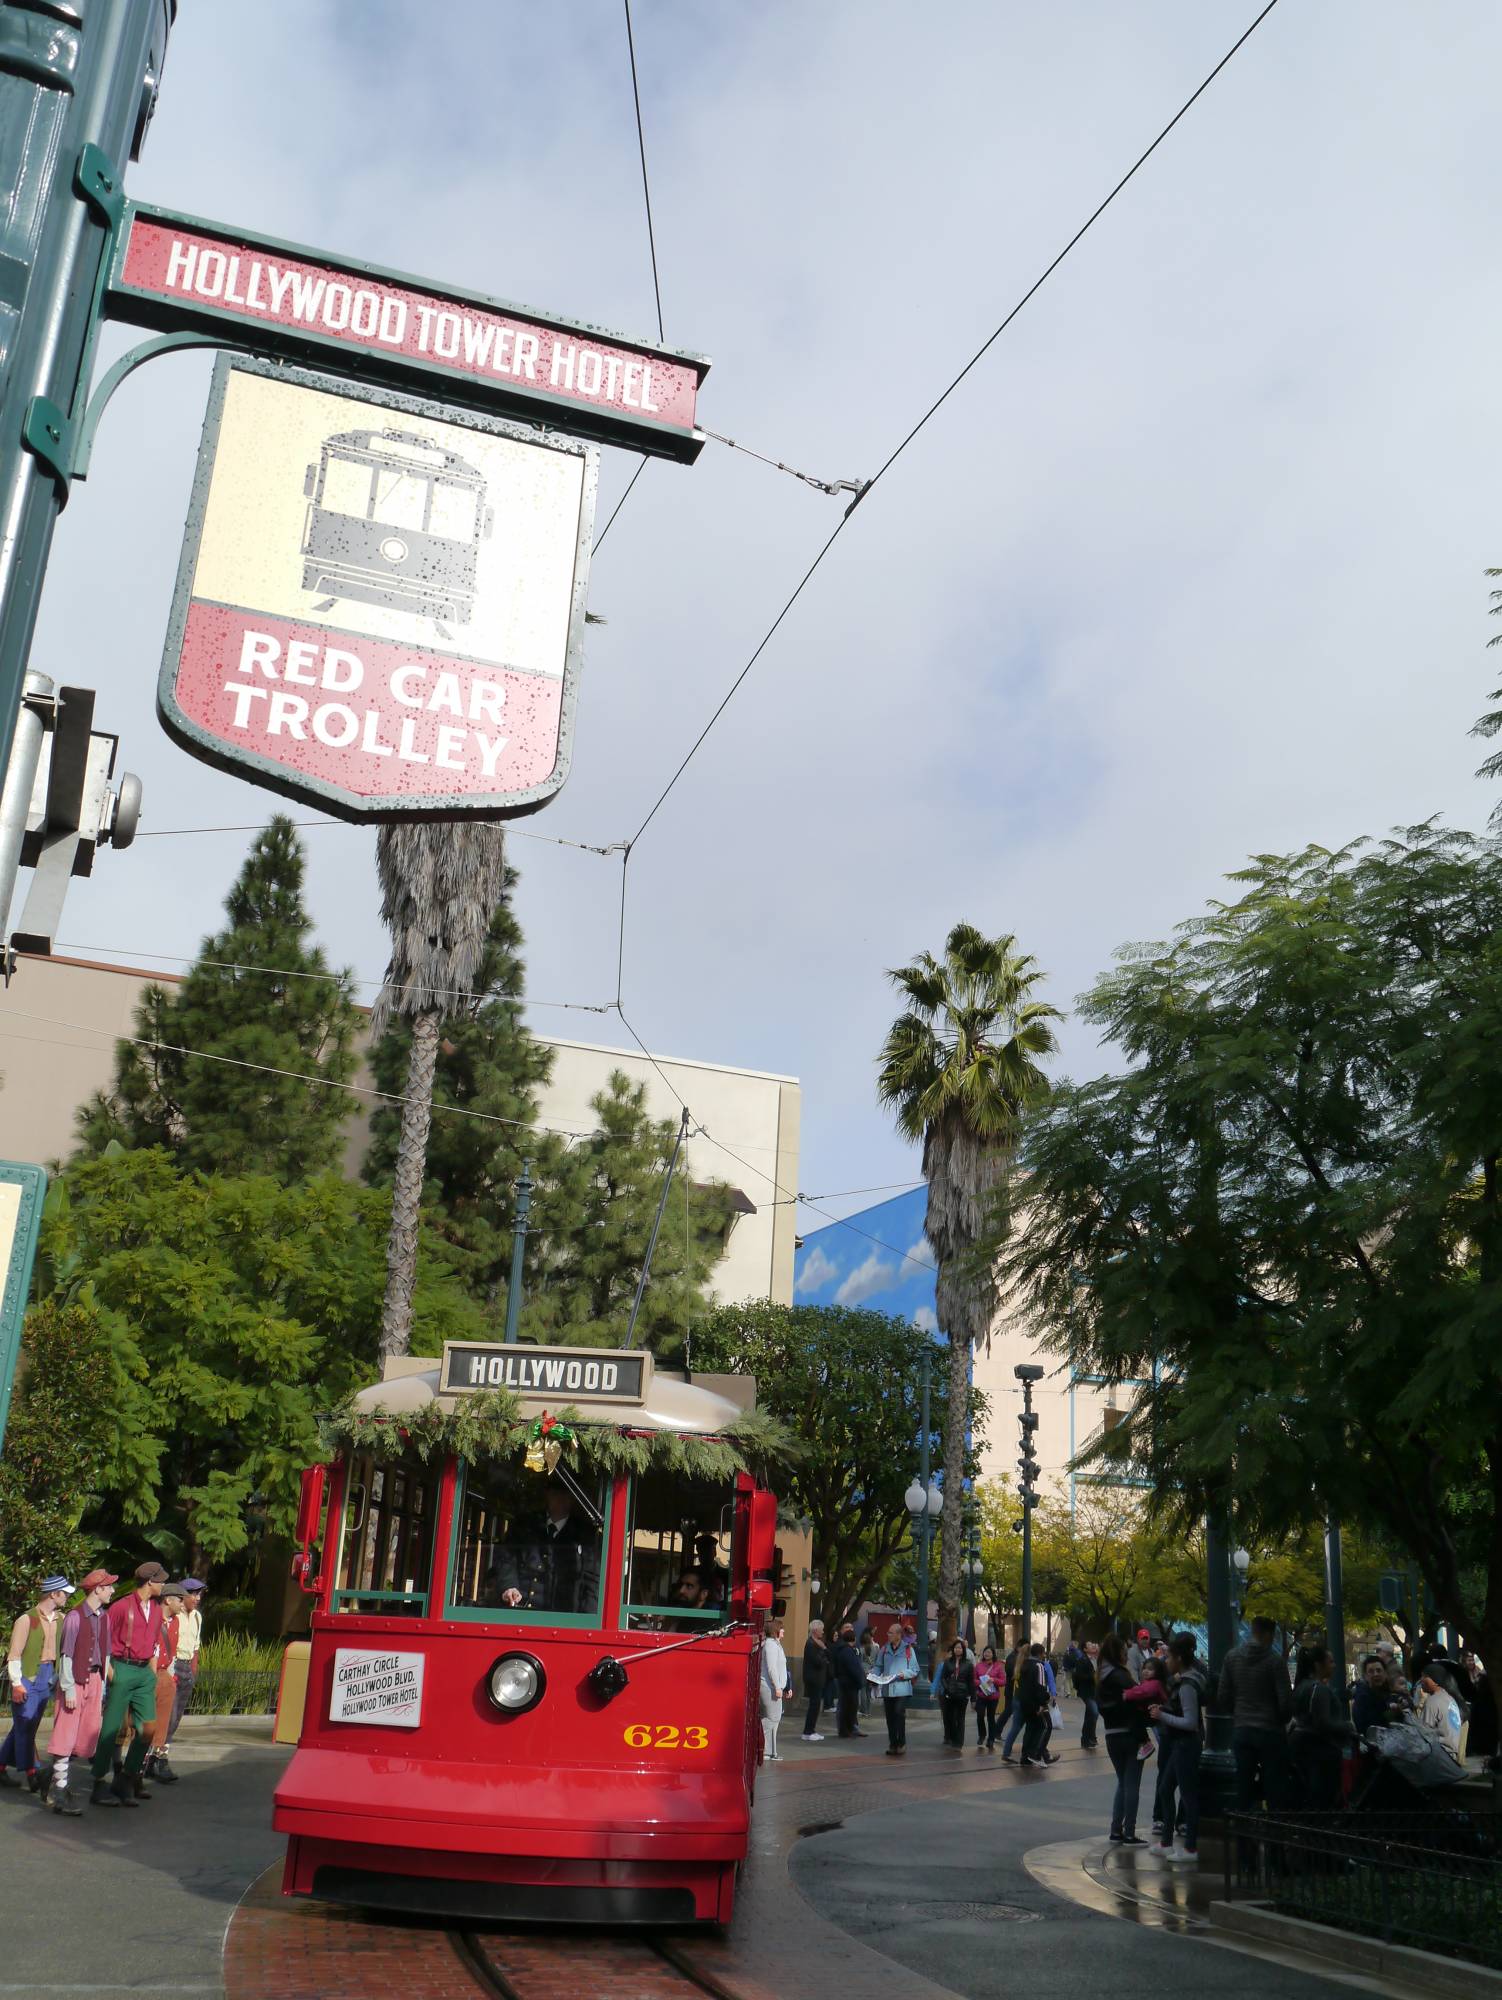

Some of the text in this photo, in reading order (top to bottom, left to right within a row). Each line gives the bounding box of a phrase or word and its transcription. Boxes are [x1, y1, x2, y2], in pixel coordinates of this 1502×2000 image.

[166, 240, 659, 412] HOLLYWOOD TOWER HOTEL
[238, 630, 507, 725] RED CAR
[223, 681, 510, 777] TROLLEY
[470, 1356, 618, 1391] HOLLYWOOD
[338, 1656, 399, 1682] CARTHAY CIRCLE
[346, 1671, 415, 1698] HOLLYWOOD BLVD.
[342, 1687, 418, 1717] HOLLYWOOD TOWER HOTEL
[623, 1724, 709, 1749] 623
